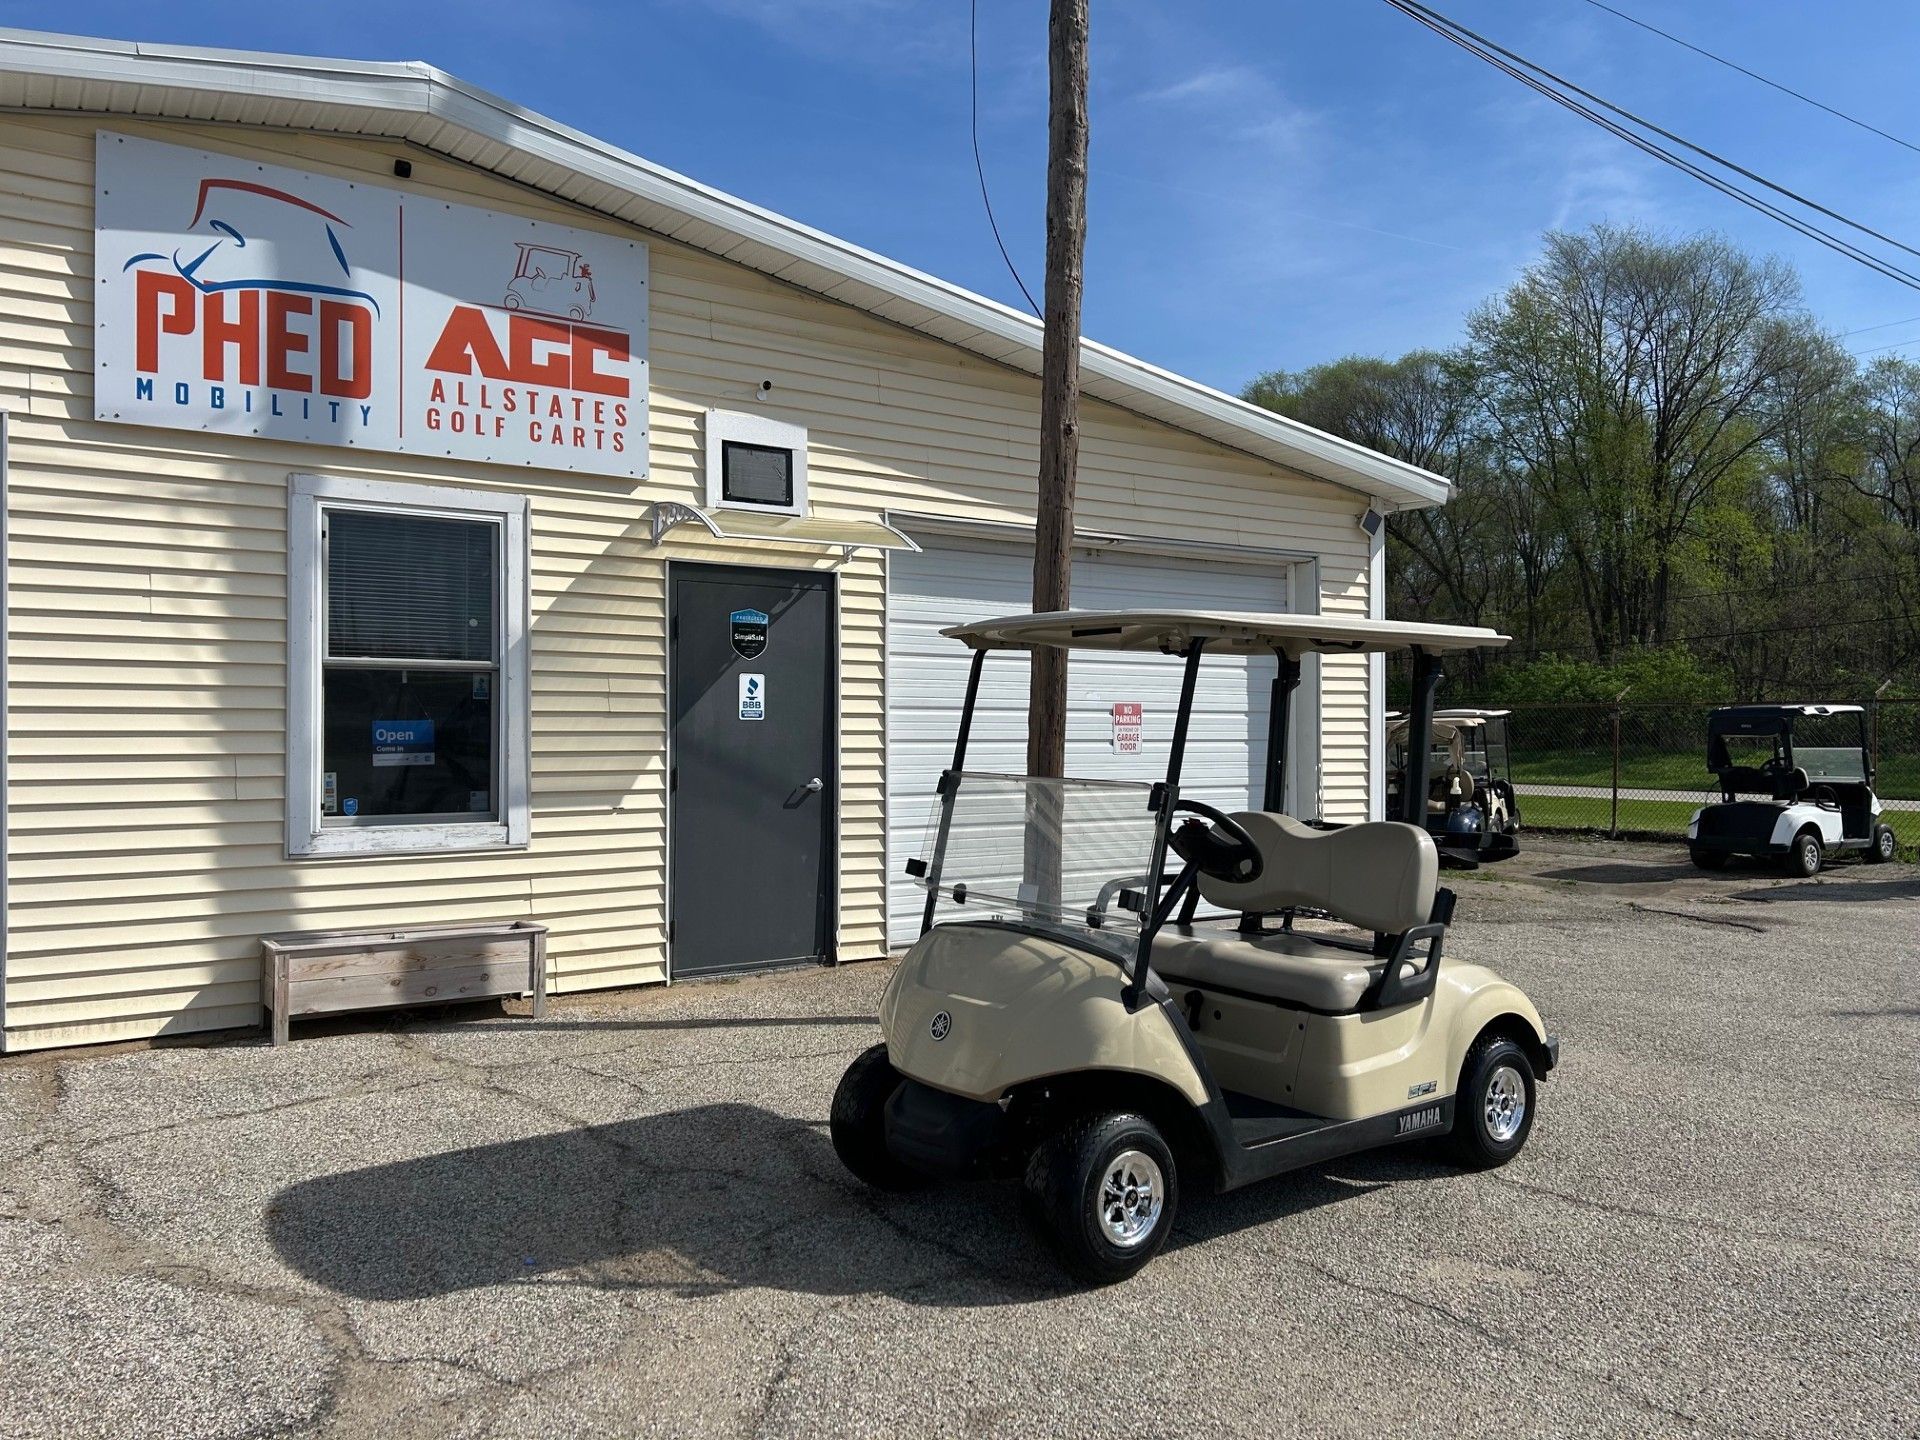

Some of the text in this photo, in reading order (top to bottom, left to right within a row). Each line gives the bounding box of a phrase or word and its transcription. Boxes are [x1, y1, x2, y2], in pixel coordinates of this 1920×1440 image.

[136, 270, 371, 399] PHED
[425, 305, 630, 398] AGC
[136, 377, 371, 427] MOBILITY
[430, 379, 628, 427] ALLSTATES
[426, 408, 625, 453] GOLF CARTS
[734, 632, 765, 642] SimpliSafe
[742, 701, 761, 709] BBB
[1123, 706, 1133, 715] NO
[1115, 715, 1141, 724] PARKING
[375, 729, 414, 744] Open
[1116, 733, 1140, 742] GARAGE
[1120, 743, 1137, 751] DOOR
[1399, 1106, 1441, 1133] YAMAHA
